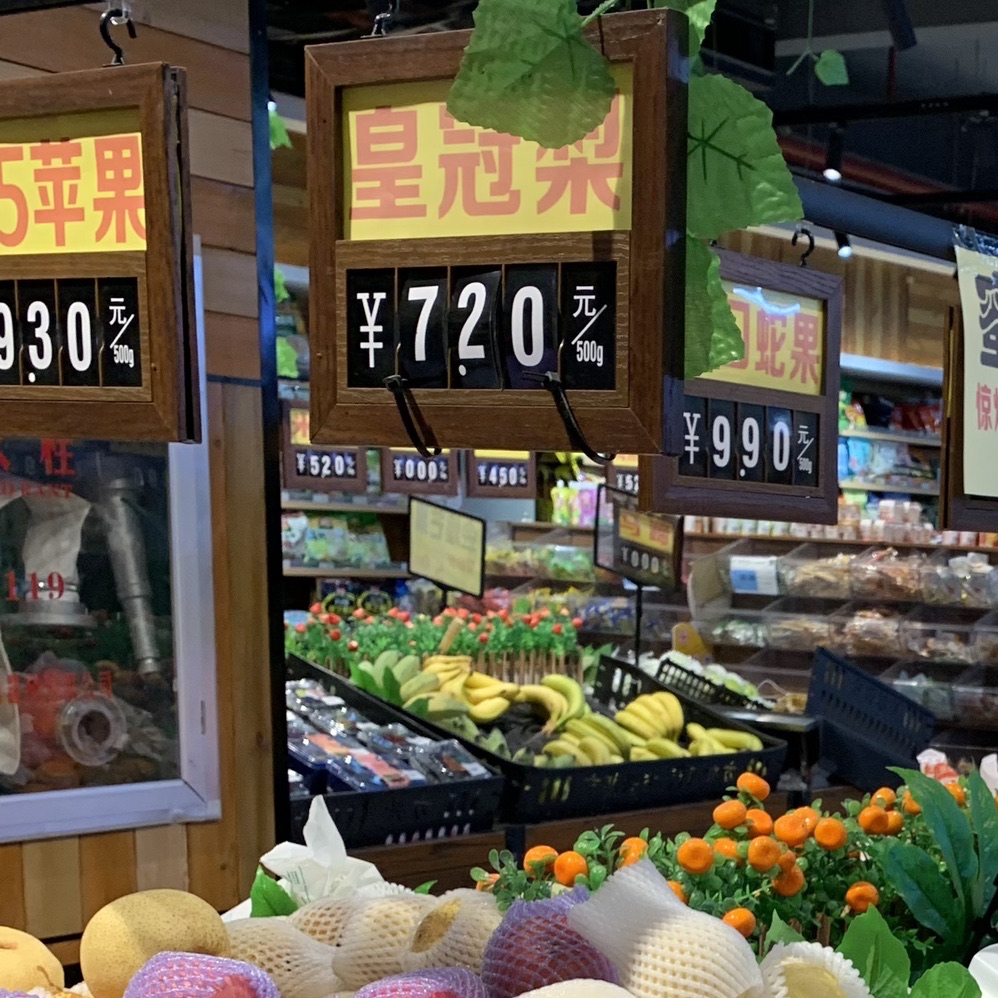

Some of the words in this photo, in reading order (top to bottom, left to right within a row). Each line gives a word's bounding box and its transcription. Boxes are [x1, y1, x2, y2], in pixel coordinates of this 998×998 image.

[349, 90, 624, 221] 皇冠梨
[6, 571, 65, 602] 119
